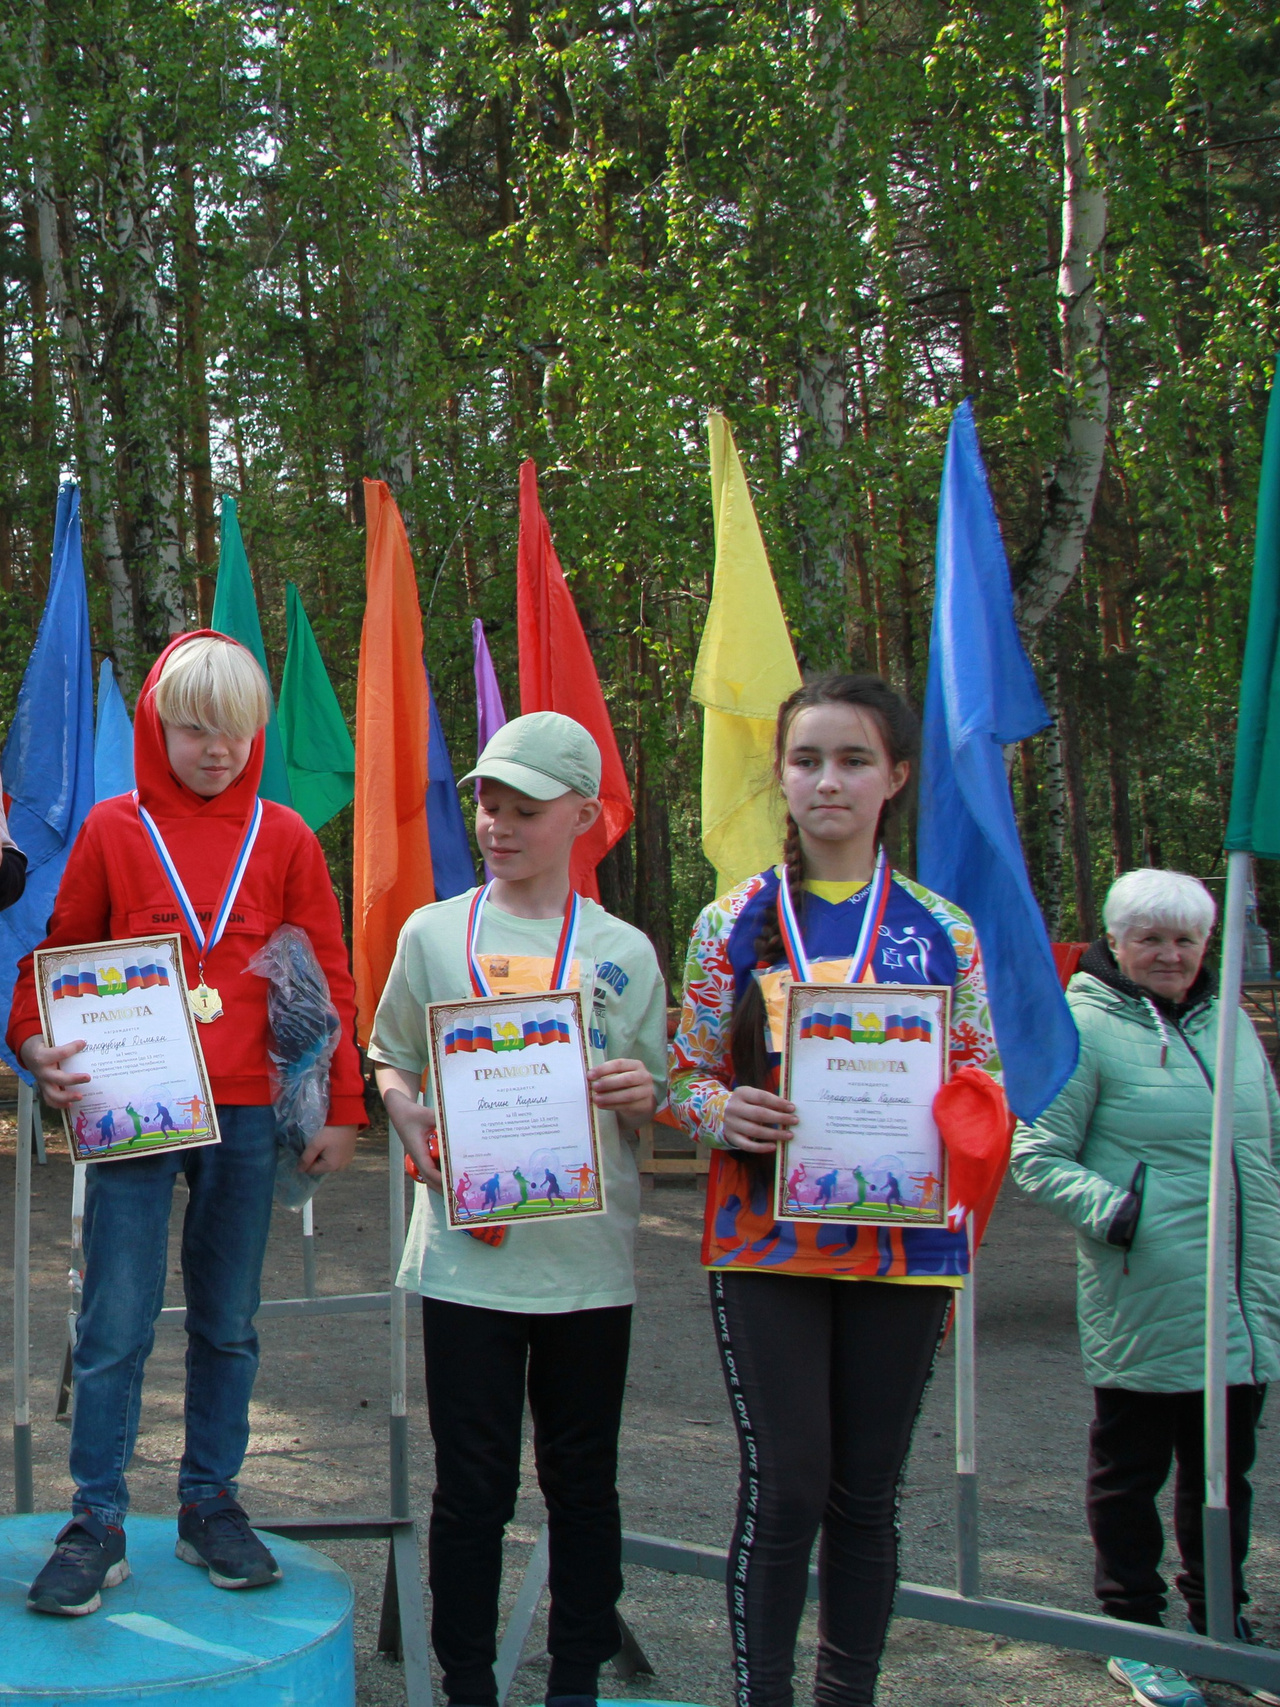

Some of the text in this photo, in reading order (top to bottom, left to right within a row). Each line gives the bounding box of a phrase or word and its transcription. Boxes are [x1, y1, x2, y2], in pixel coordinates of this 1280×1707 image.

[82, 1005, 152, 1024] ГРАМОТА
[202, 999, 208, 1008] 1
[133, 1035, 167, 1046] Демьян
[474, 1063, 550, 1080] ГРАМОТА
[827, 1058, 908, 1072] ГРАМОТА
[516, 1095, 547, 1107] Кирилл
[715, 1272, 724, 1298] OVE
[717, 1306, 730, 1342] LOVE
[724, 1350, 740, 1386] LOVE
[734, 1393, 752, 1430] LOVE
[745, 1435, 758, 1473] LOVE
[747, 1477, 759, 1514] LOVE
[740, 1518, 756, 1547] LOVE
[734, 1550, 750, 1583] LOVE
[734, 1586, 745, 1619] LOVE
[735, 1623, 747, 1652] LOVE
